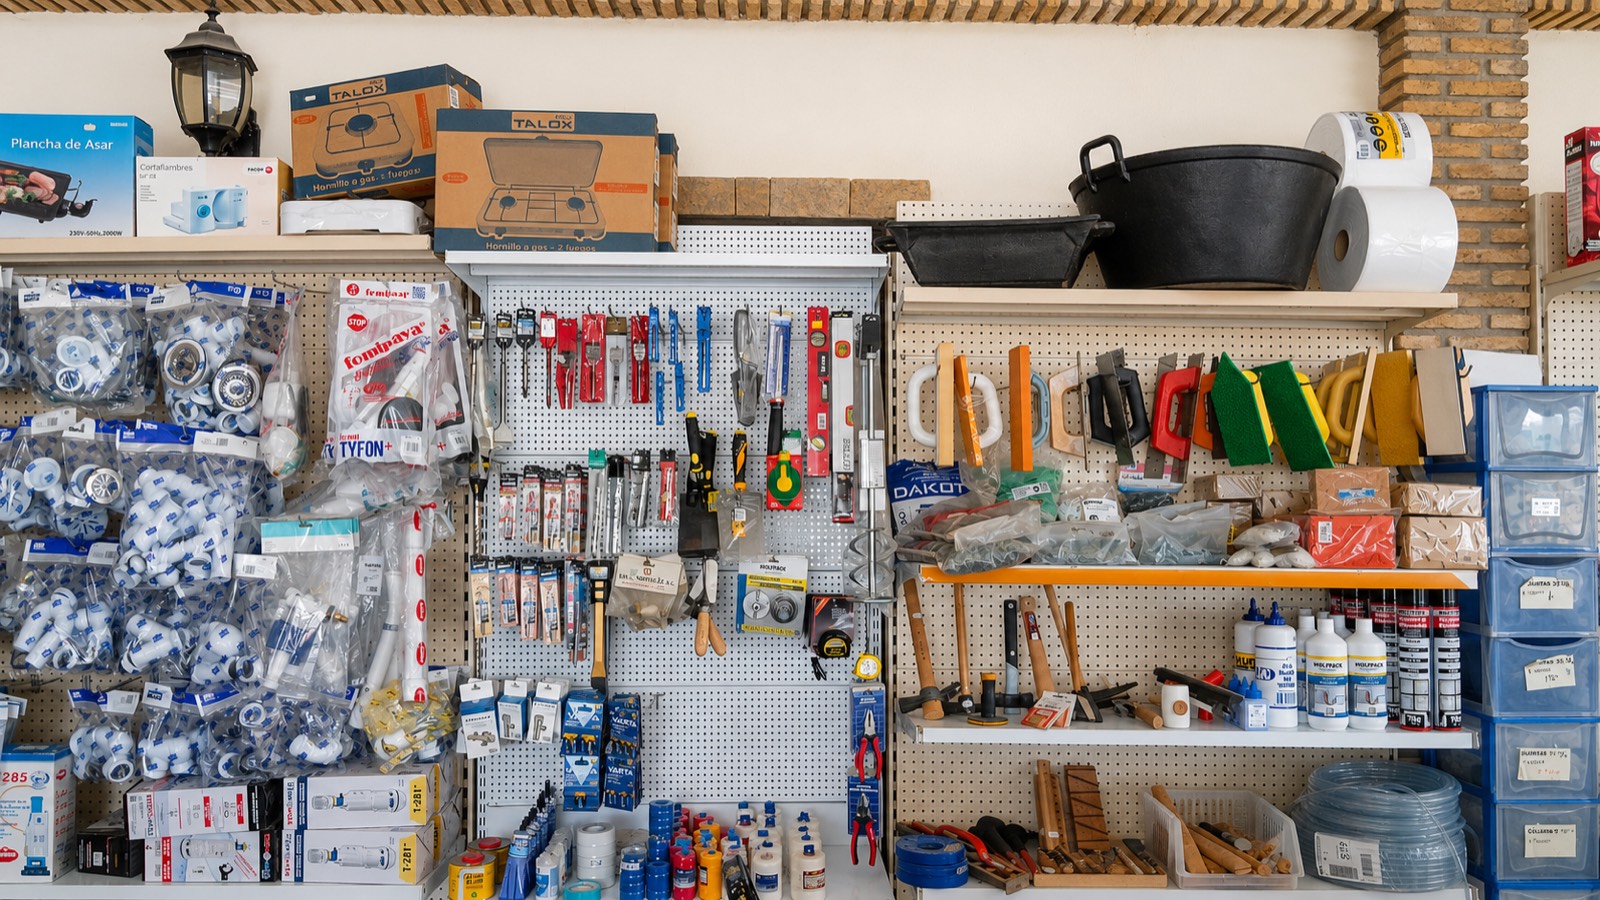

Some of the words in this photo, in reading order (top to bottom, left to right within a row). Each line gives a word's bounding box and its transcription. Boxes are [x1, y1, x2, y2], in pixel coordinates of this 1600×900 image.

[331, 84, 385, 101] TALOX
[513, 119, 573, 130] TALOX
[11, 138, 62, 150] Plancha
[65, 138, 81, 150] de
[84, 139, 114, 151] Asar
[485, 241, 522, 251] Hornillo
[347, 317, 367, 327] STOP
[608, 766, 633, 776] VARTA
[2, 772, 28, 783] 285
